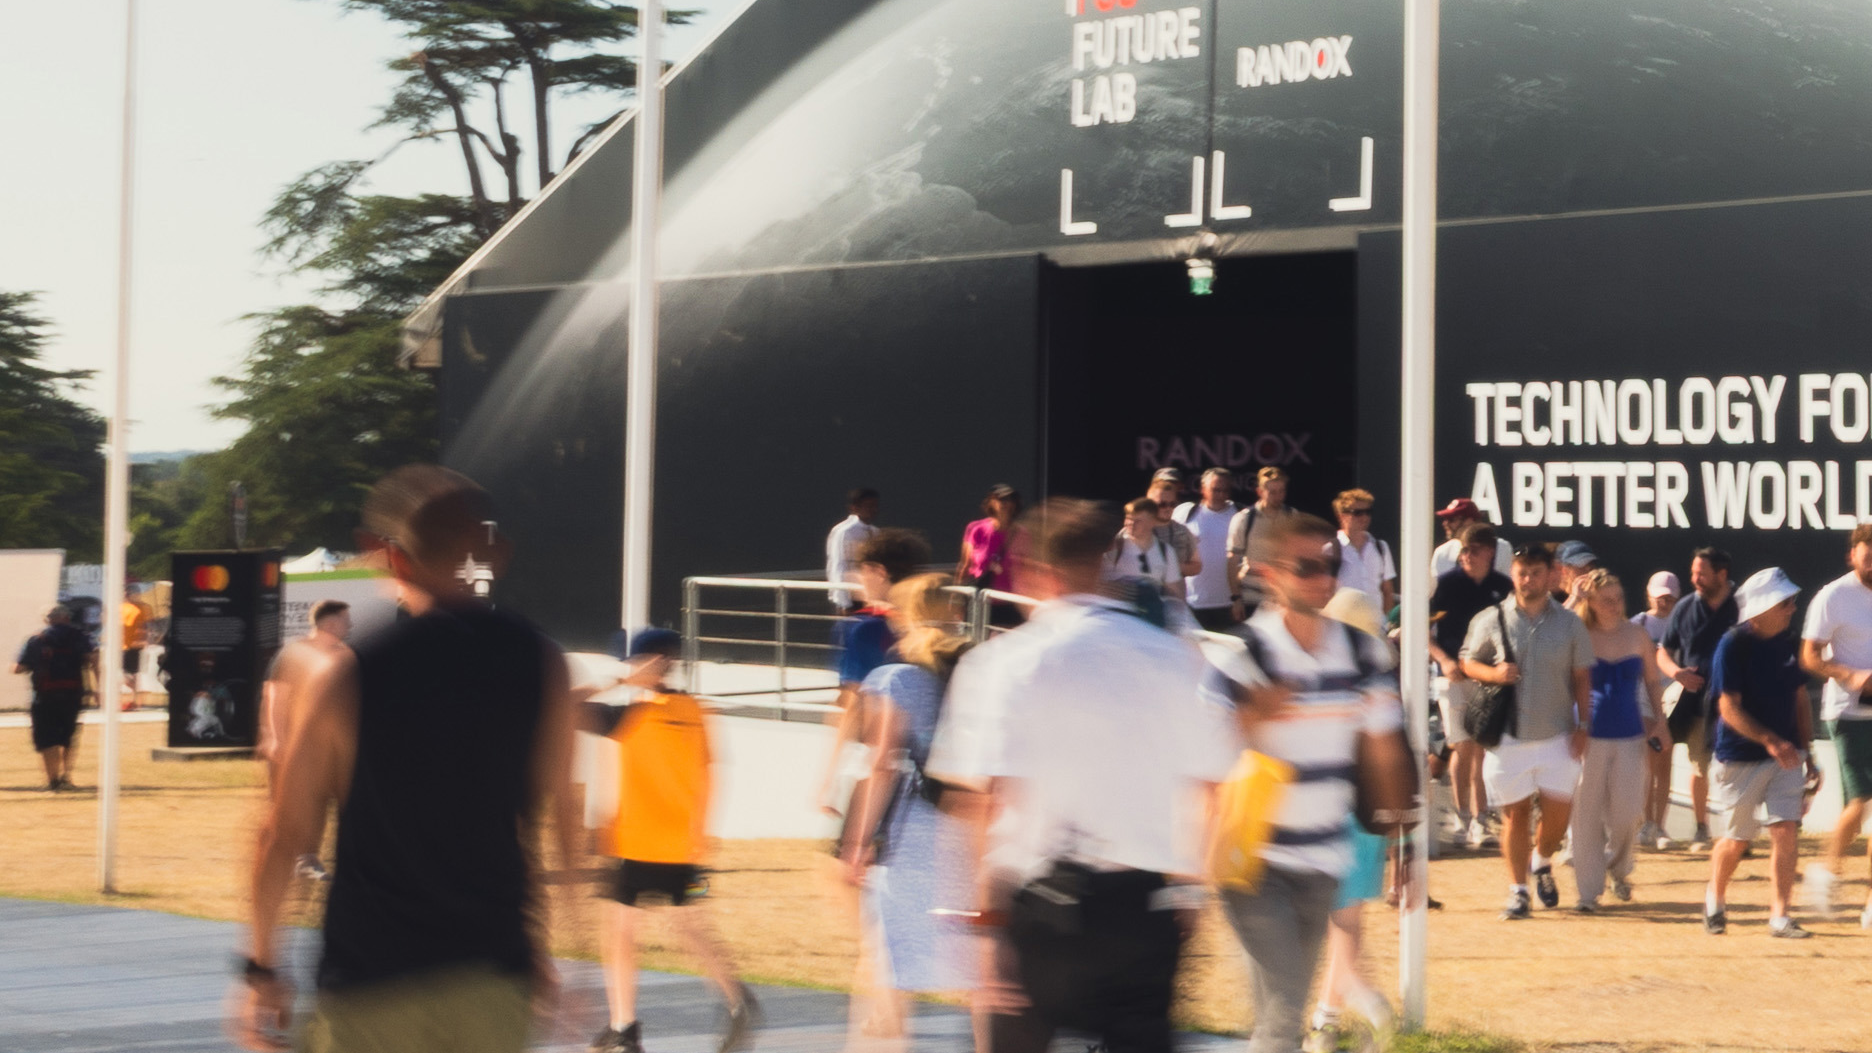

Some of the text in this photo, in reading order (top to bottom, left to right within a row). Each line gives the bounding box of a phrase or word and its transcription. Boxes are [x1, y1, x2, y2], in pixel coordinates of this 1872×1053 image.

[1072, 6, 1201, 72] FUTURE
[1236, 34, 1354, 88] RANDOX
[1070, 72, 1137, 127] LAB
[1466, 375, 1787, 447] TECHNOLOGY
[1136, 432, 1313, 470] RANDOX
[1471, 462, 1502, 526] A
[1512, 461, 1690, 528] BETTER
